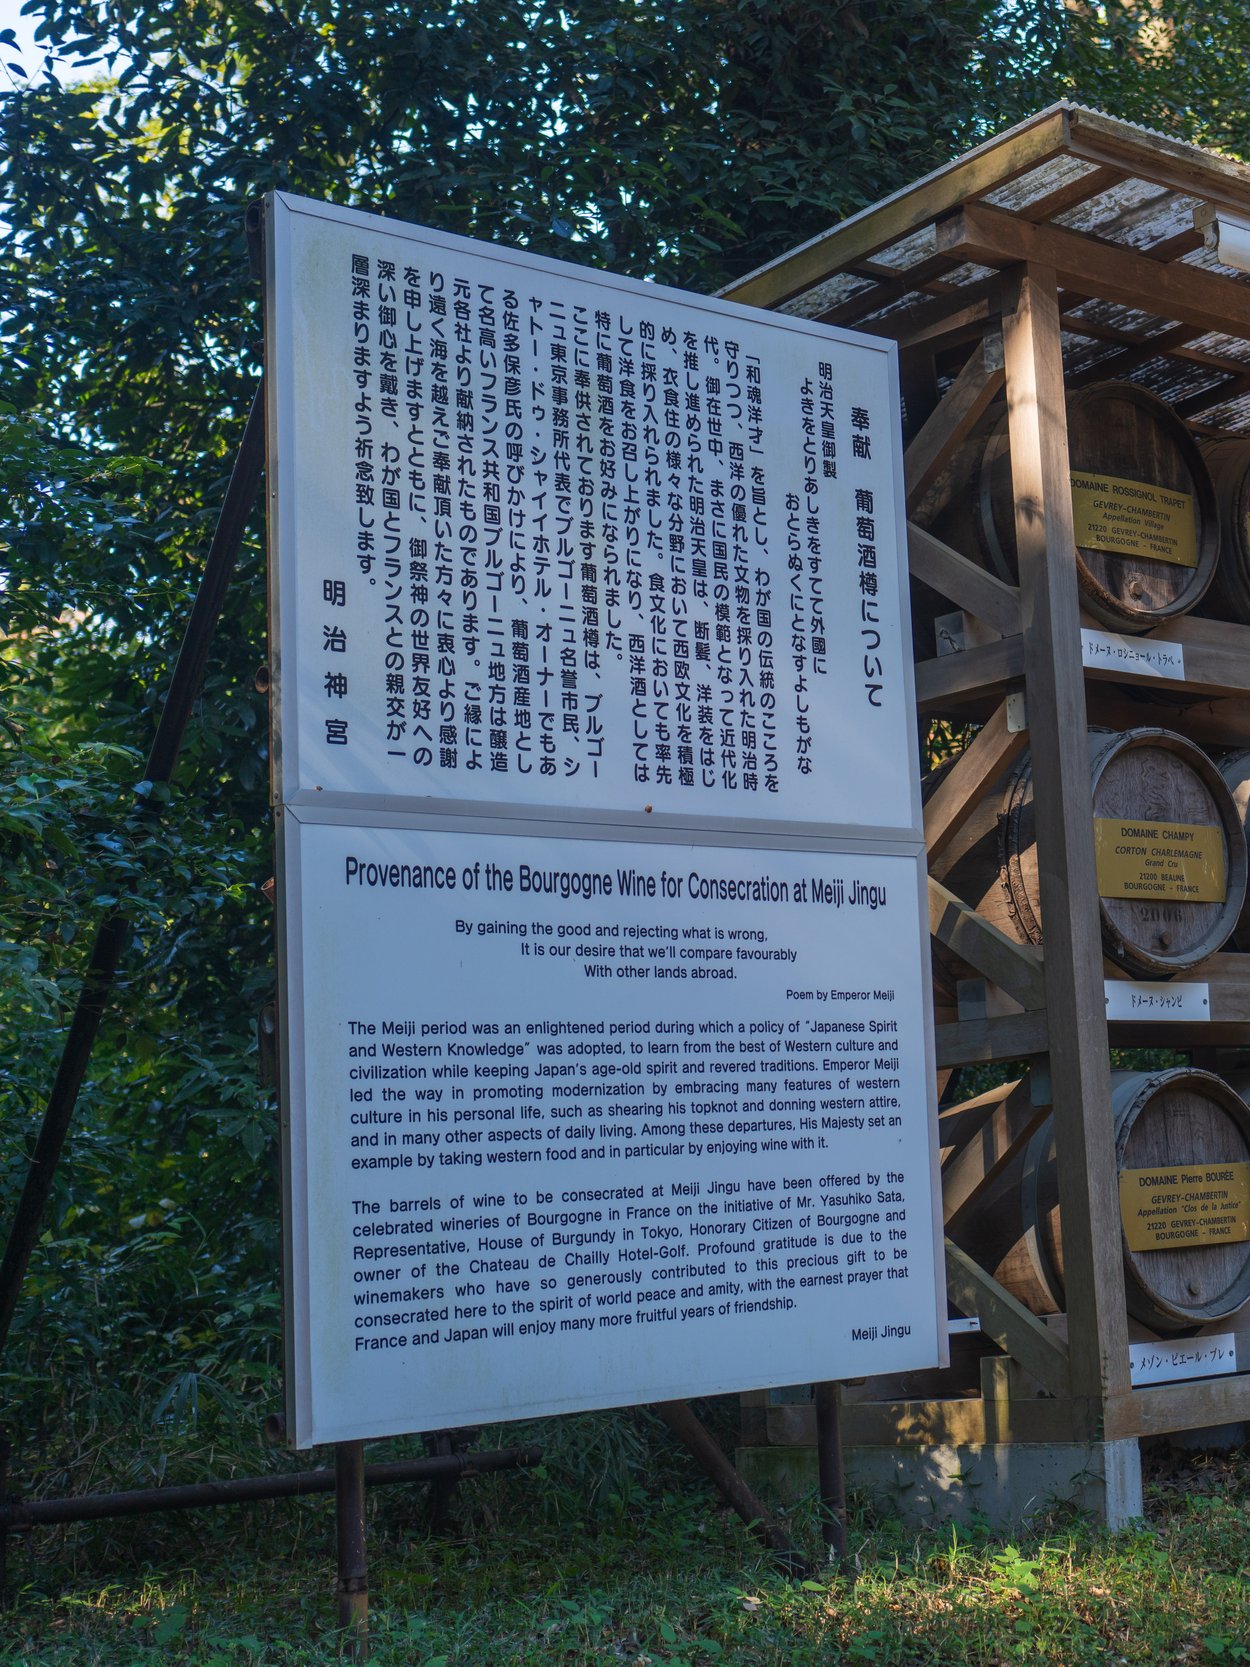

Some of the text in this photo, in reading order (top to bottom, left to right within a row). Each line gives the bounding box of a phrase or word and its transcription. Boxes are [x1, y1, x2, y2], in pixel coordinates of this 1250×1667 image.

[350, 253, 377, 586] 層深まりますよう祈念致します。
[818, 361, 838, 480] 明治天皇御製
[594, 309, 623, 661] 特に葡萄酒をお好みになられました。
[1112, 485, 1157, 502] ROSSIGNOL
[1160, 495, 1186, 509] TRAPET
[1093, 500, 1171, 522] GEVREY-CHAMBERTIN
[800, 377, 828, 675] よきをとりあしきをすてて外國に
[1102, 512, 1165, 531] Appellation Village
[1087, 523, 1178, 546] 21220 GEVREY-CHAMBERTIN
[1096, 534, 1172, 554] BOURGOGNE FRANCE
[850, 406, 884, 708] 奉献 葡萄酒樽について
[785, 492, 813, 775] おとらぬくにとなすよしもがな
[322, 579, 349, 746] 明治神宮
[1121, 827, 1194, 841] DOMAINE CHAMPY
[1115, 846, 1203, 860] CORTON CHARLEMAGNE
[1145, 859, 1178, 868] Grand Cru
[345, 856, 887, 911] Provenance of the Bourgogne Wine for Consecration at Meiji Jingu
[1139, 873, 1185, 882] 21200 BEAUNE
[1124, 882, 1200, 893] BOURGOGNE FRANCE
[455, 919, 768, 943] By gaining the good and rejecting what is wrong,
[521, 942, 798, 963] It is our desire that we'll compare favourably
[583, 963, 737, 980] With other lands abroad.
[786, 989, 895, 1002] Poem by Emperor Meiji
[347, 1021, 377, 1036] The
[381, 1020, 416, 1038] Meiji
[421, 1020, 468, 1038] period
[471, 1023, 500, 1035] was
[504, 1023, 521, 1035] an
[525, 1020, 605, 1037] enlightened
[609, 1020, 651, 1037] period
[654, 1020, 695, 1036] during
[698, 1020, 734, 1034] which
[737, 1022, 746, 1034] a
[749, 1020, 785, 1036] policy
[787, 1020, 801, 1033] of
[868, 1019, 898, 1035] Spirit
[1139, 1170, 1234, 1187] DOMAINE Pierre BOURÉE
[1151, 1190, 1229, 1204] GEVREY-CHAMBERTIN
[1137, 1206, 1177, 1218] Appellation
[1200, 1203, 1209, 1212] de
[1212, 1202, 1217, 1211] la
[1146, 1215, 1237, 1231] 21220 GEVREY-CHAMBERTIN
[1155, 1226, 1232, 1240] BOURGOGNE FRANCE
[851, 1324, 911, 1342] Meiji Jingu
